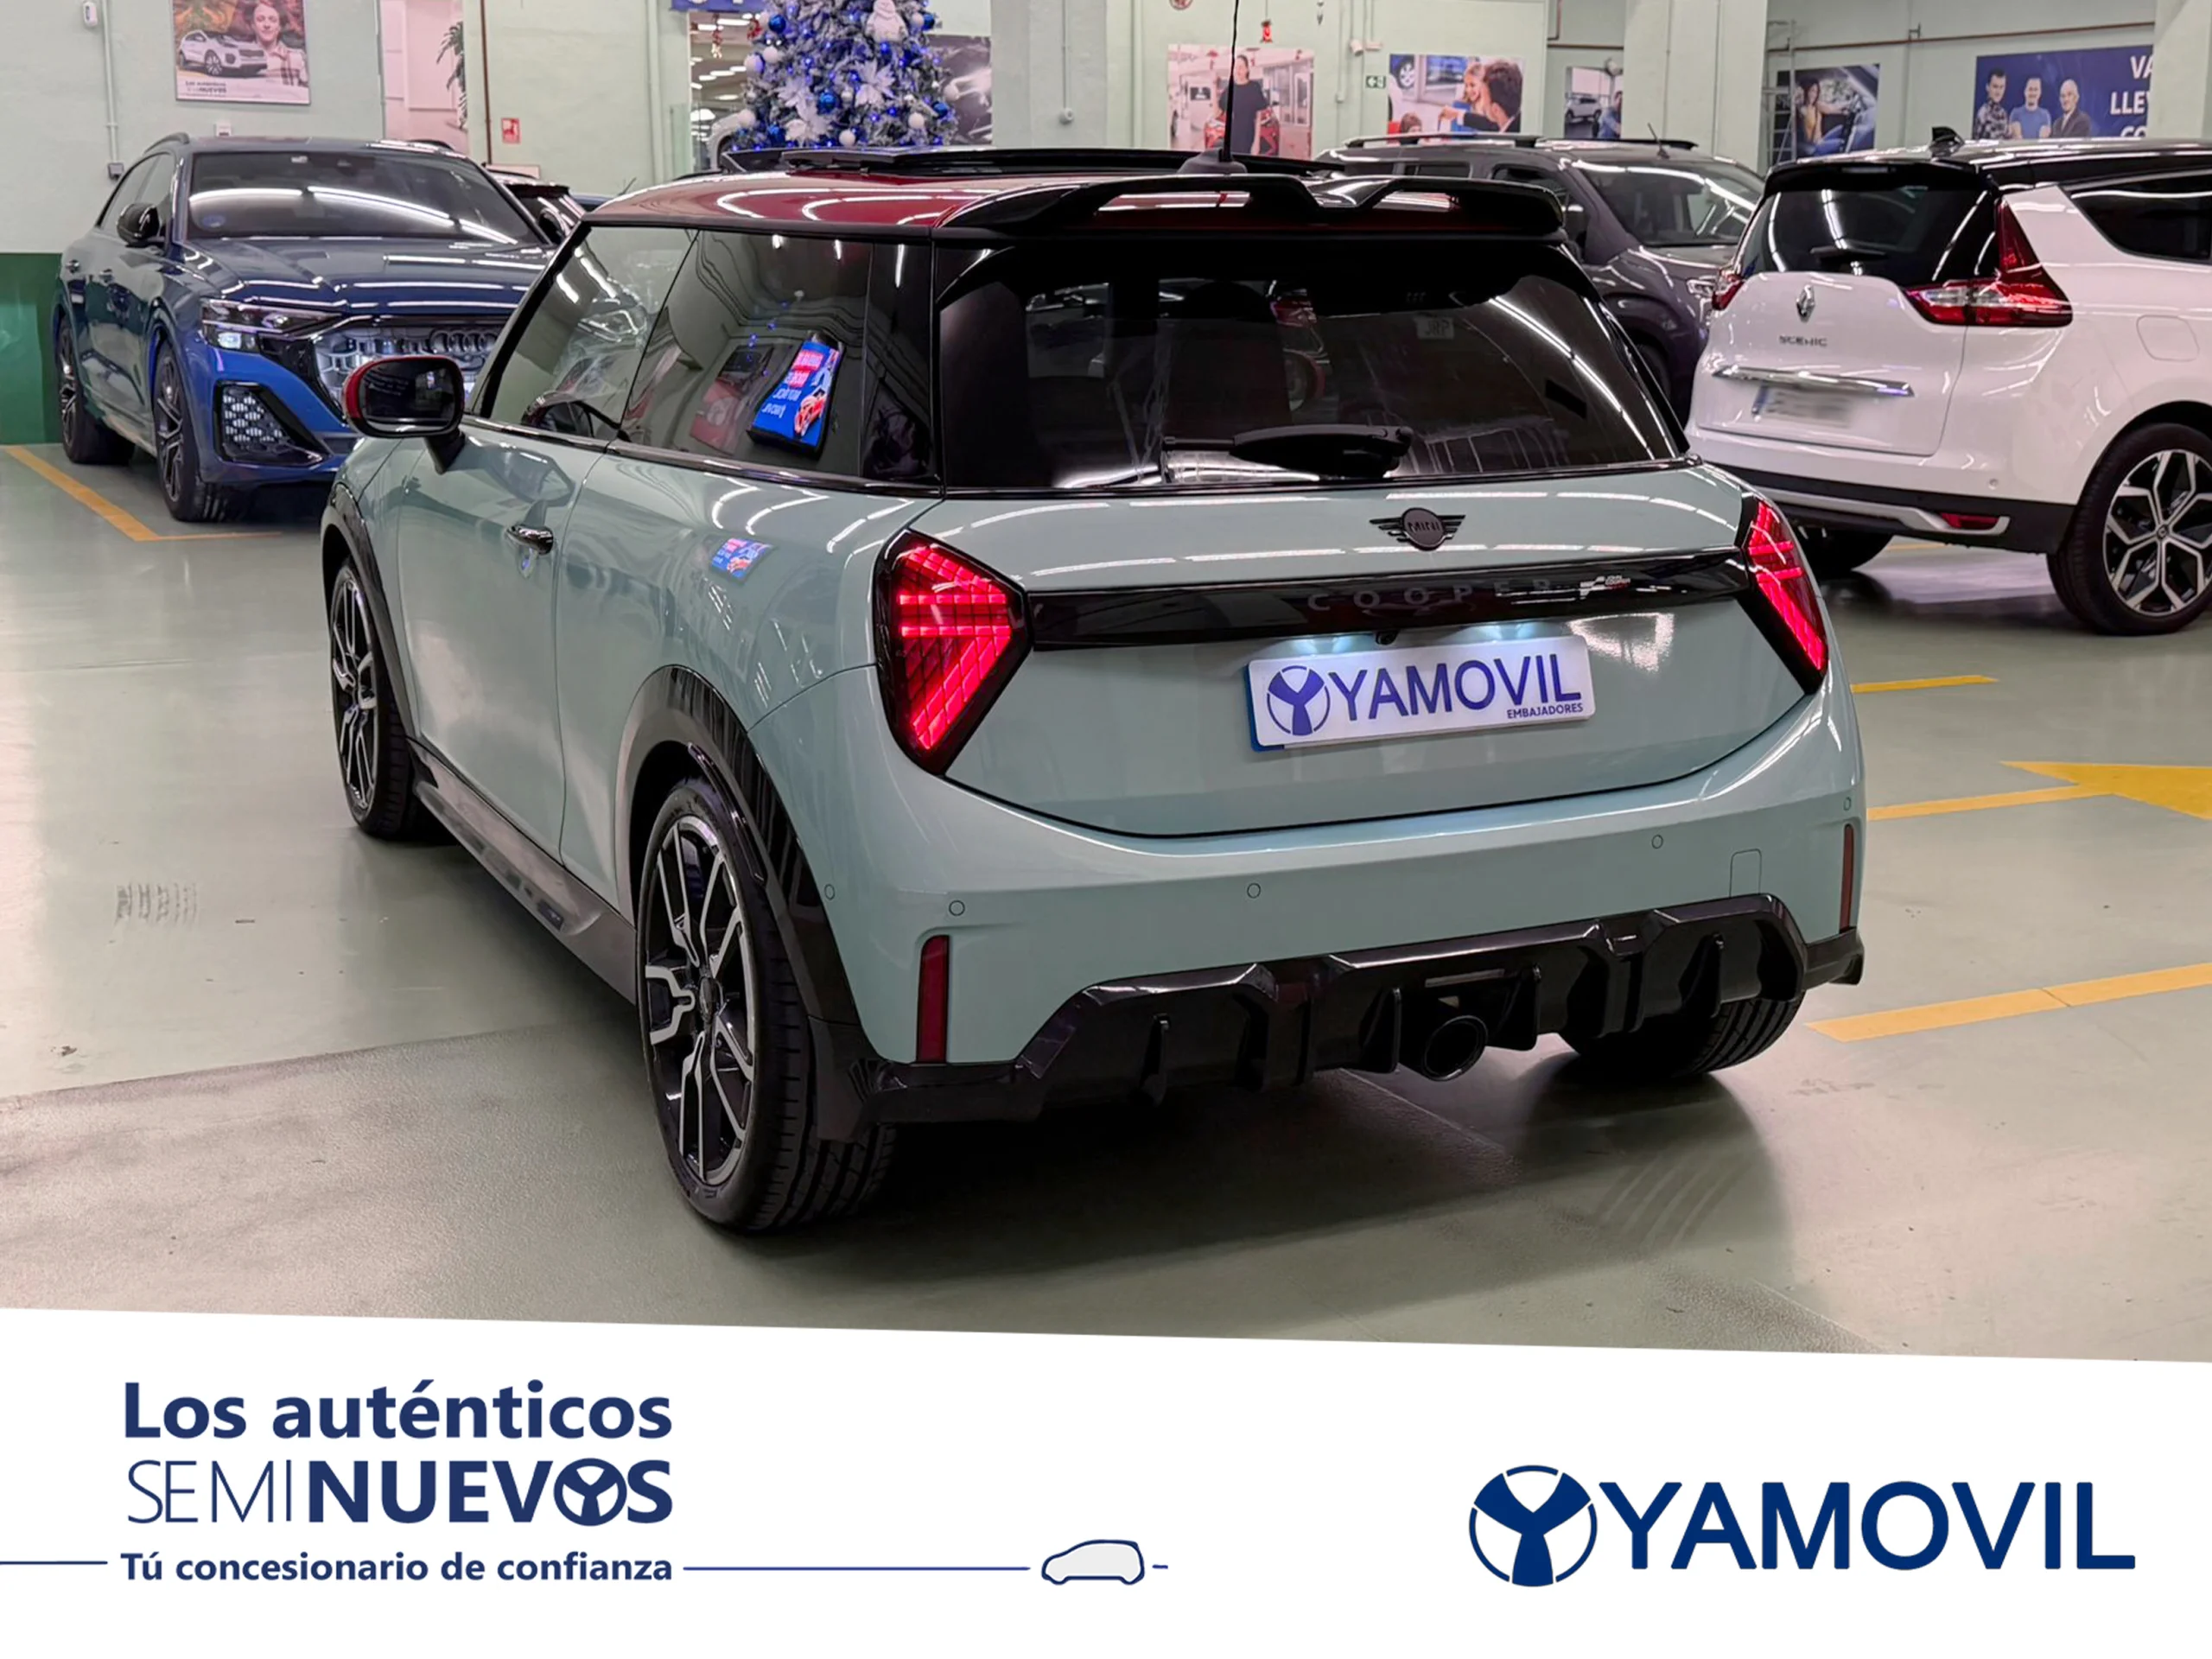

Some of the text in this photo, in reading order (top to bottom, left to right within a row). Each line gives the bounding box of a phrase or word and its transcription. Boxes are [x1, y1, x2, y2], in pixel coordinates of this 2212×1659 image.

[1408, 520, 1441, 532] MINI
[1307, 580, 1552, 610] COOPER
[1328, 654, 1581, 721] YAMOVIL
[1507, 703, 1583, 720] EMBAJADORES
